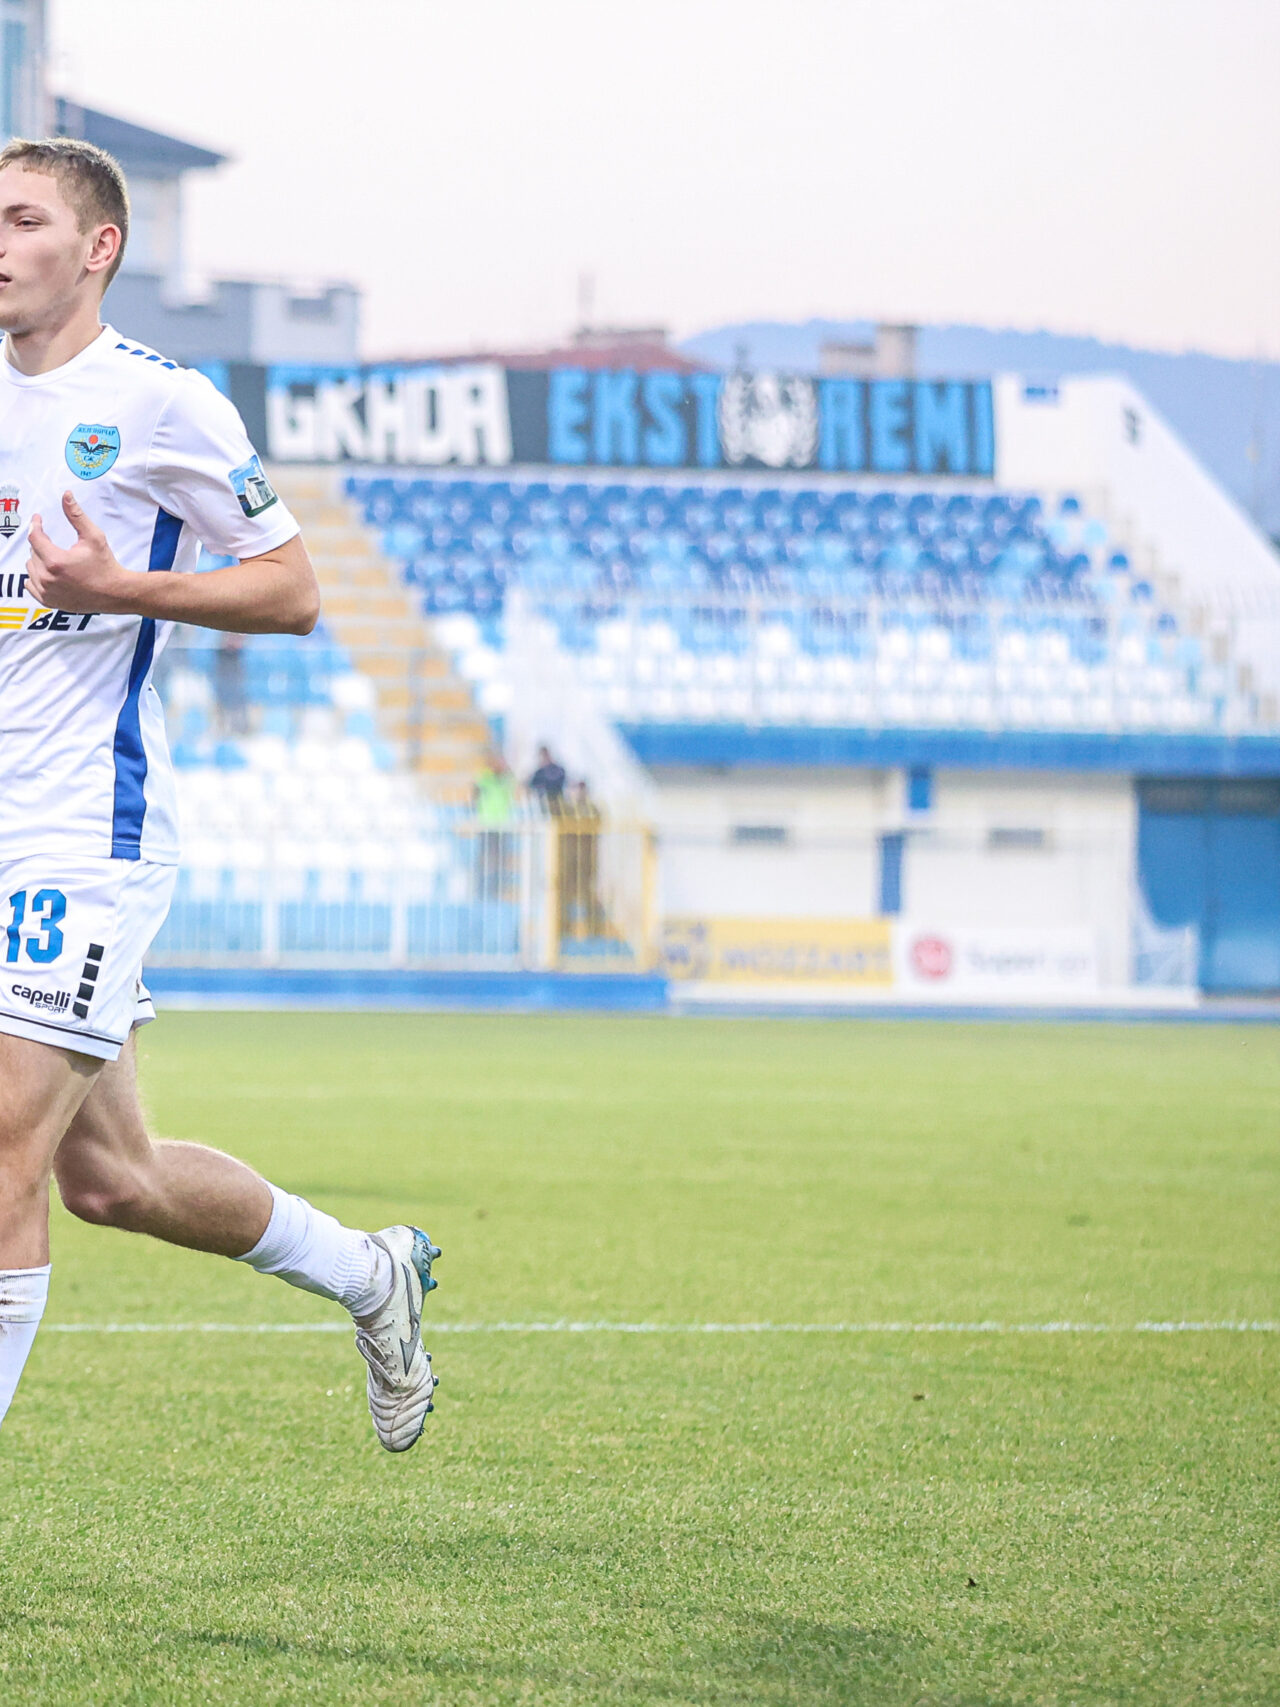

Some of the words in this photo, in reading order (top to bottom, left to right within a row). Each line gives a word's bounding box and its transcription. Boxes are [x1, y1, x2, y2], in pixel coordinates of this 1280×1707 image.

[27, 608, 101, 632] BET
[6, 888, 67, 964] 13
[11, 983, 71, 1009] capelli
[34, 1001, 68, 1015] SPORT
